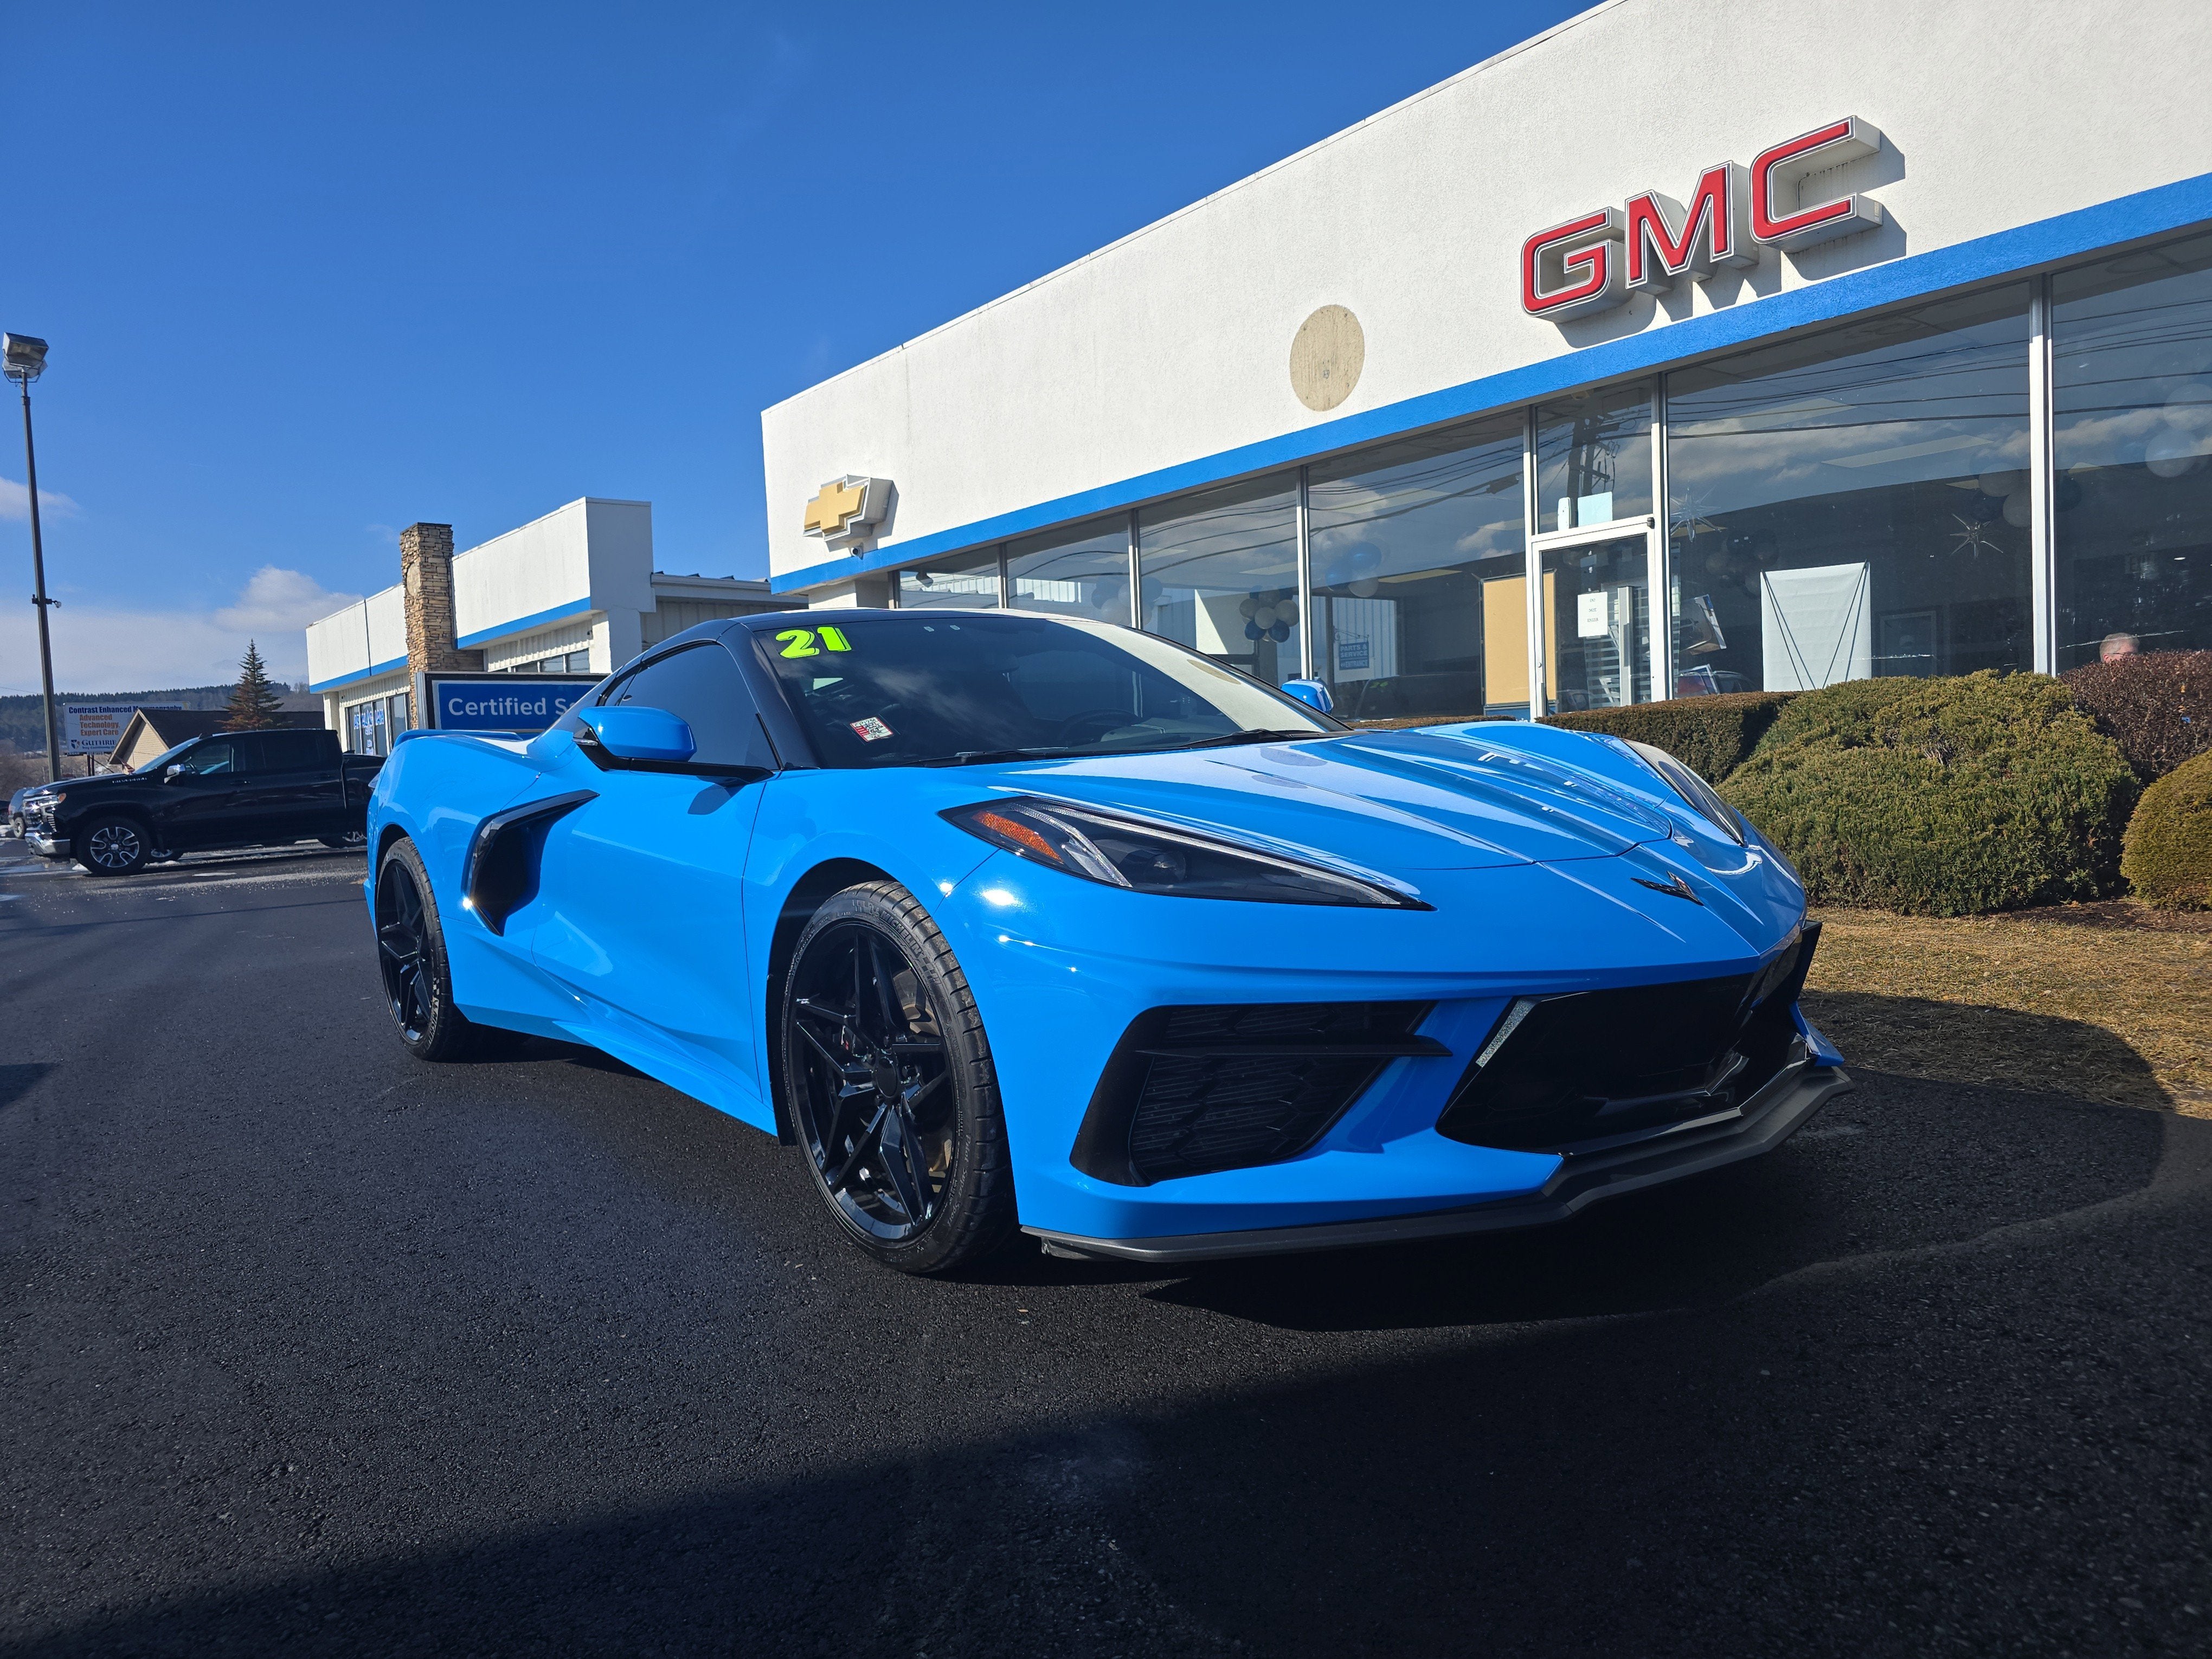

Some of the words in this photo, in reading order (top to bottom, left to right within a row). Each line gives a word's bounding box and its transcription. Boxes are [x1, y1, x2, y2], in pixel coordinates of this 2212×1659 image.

[1521, 115, 1857, 317] GMC
[776, 627, 852, 658] 21
[448, 698, 546, 716] Certified
[880, 911, 924, 959] MICHELIN
[964, 1134, 972, 1163] Pilot
[957, 1168, 968, 1197] Super
[947, 1201, 962, 1227] Sport
